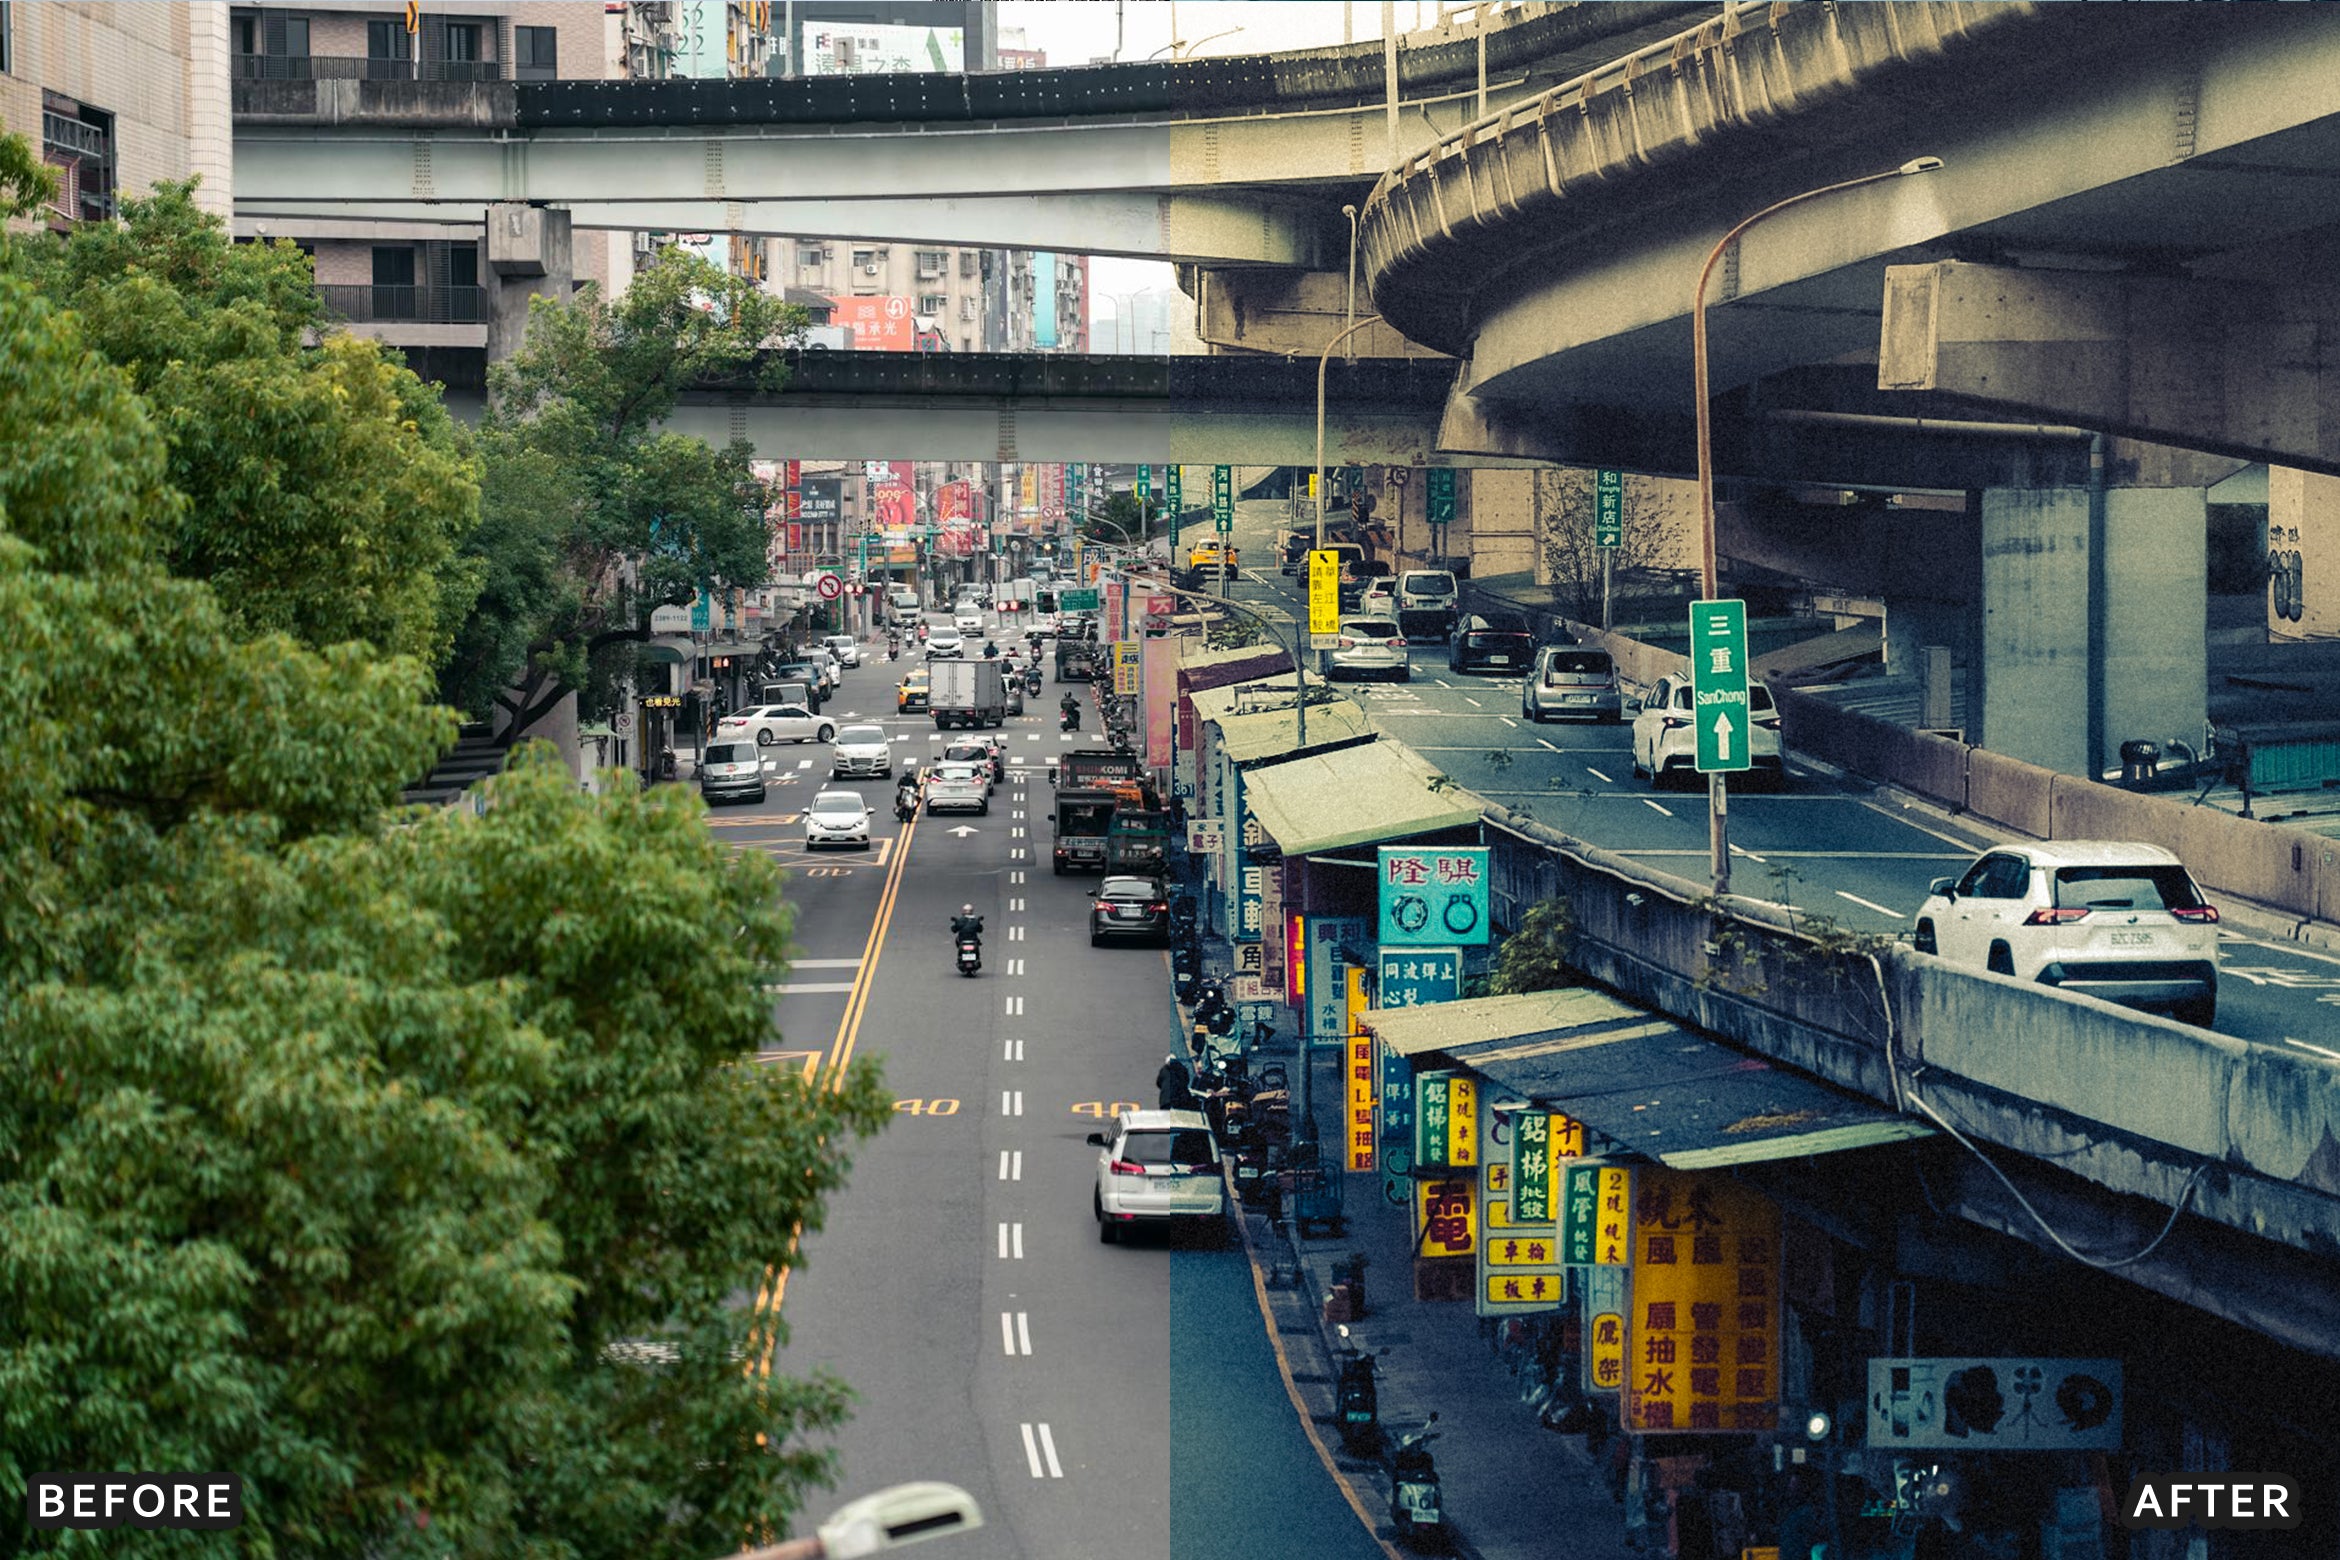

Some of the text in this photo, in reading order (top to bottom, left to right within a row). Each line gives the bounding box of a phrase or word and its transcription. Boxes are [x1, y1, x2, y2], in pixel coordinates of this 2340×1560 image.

[1602, 494, 1617, 525] 新店
[1708, 616, 1733, 673] 三重
[1697, 689, 1746, 706] SanChong
[891, 1099, 960, 1115] 40
[1071, 1101, 1141, 1118] 40
[1519, 1116, 1548, 1219] 鋁梯批發
[1426, 1182, 1472, 1251] 電
[1572, 1170, 1596, 1261] 風管批發
[1504, 1240, 1545, 1262] 車輪
[1596, 1320, 1620, 1382] 鷹架
